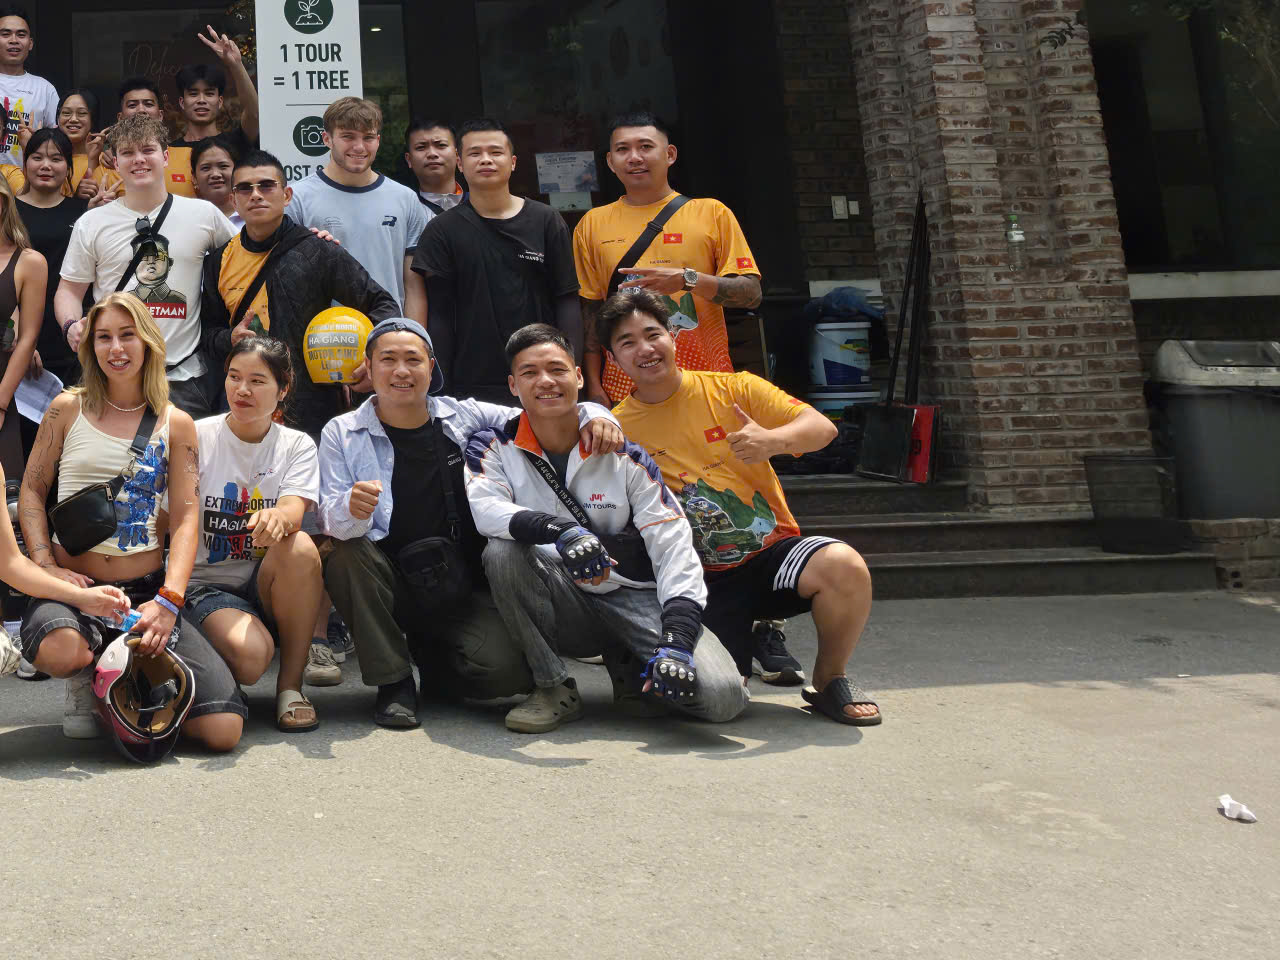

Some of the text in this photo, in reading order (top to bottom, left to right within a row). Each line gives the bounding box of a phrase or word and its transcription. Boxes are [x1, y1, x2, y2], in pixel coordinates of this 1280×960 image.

[280, 42, 342, 63] 1 TOUR
[291, 71, 300, 90] 1
[305, 70, 350, 90] TREE
[283, 164, 311, 182] OST
[148, 306, 185, 316] ETMAN
[321, 335, 355, 344] GIANG
